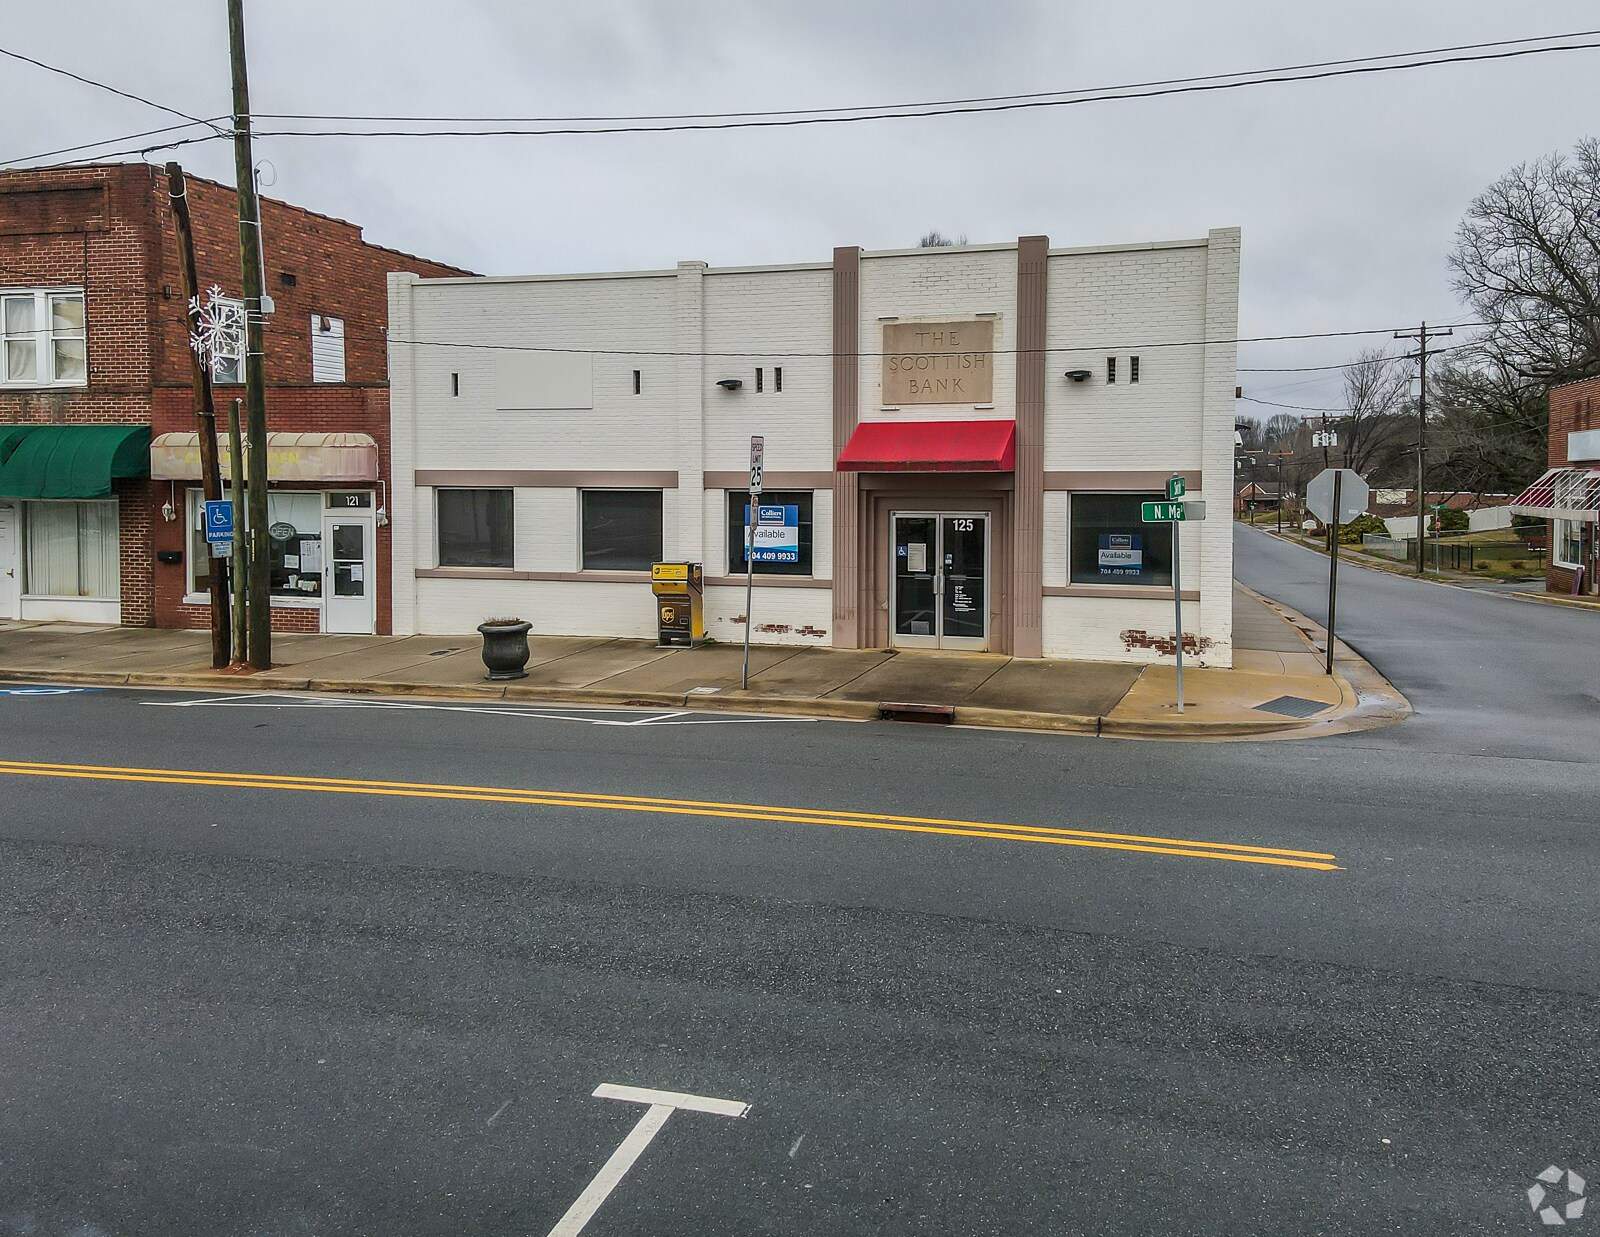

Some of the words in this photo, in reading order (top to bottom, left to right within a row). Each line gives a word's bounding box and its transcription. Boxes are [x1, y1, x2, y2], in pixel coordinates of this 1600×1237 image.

[915, 331, 960, 347] THE
[889, 354, 986, 371] SCOTTISH
[909, 378, 965, 394] BANK
[751, 466, 761, 486] 25
[345, 495, 359, 506] 121
[1154, 504, 1165, 519] N.
[271, 527, 294, 536] OPEN
[953, 519, 973, 531] 125
[761, 551, 776, 561] 409
[777, 552, 796, 561] 9933
[1100, 551, 1132, 560] Available
